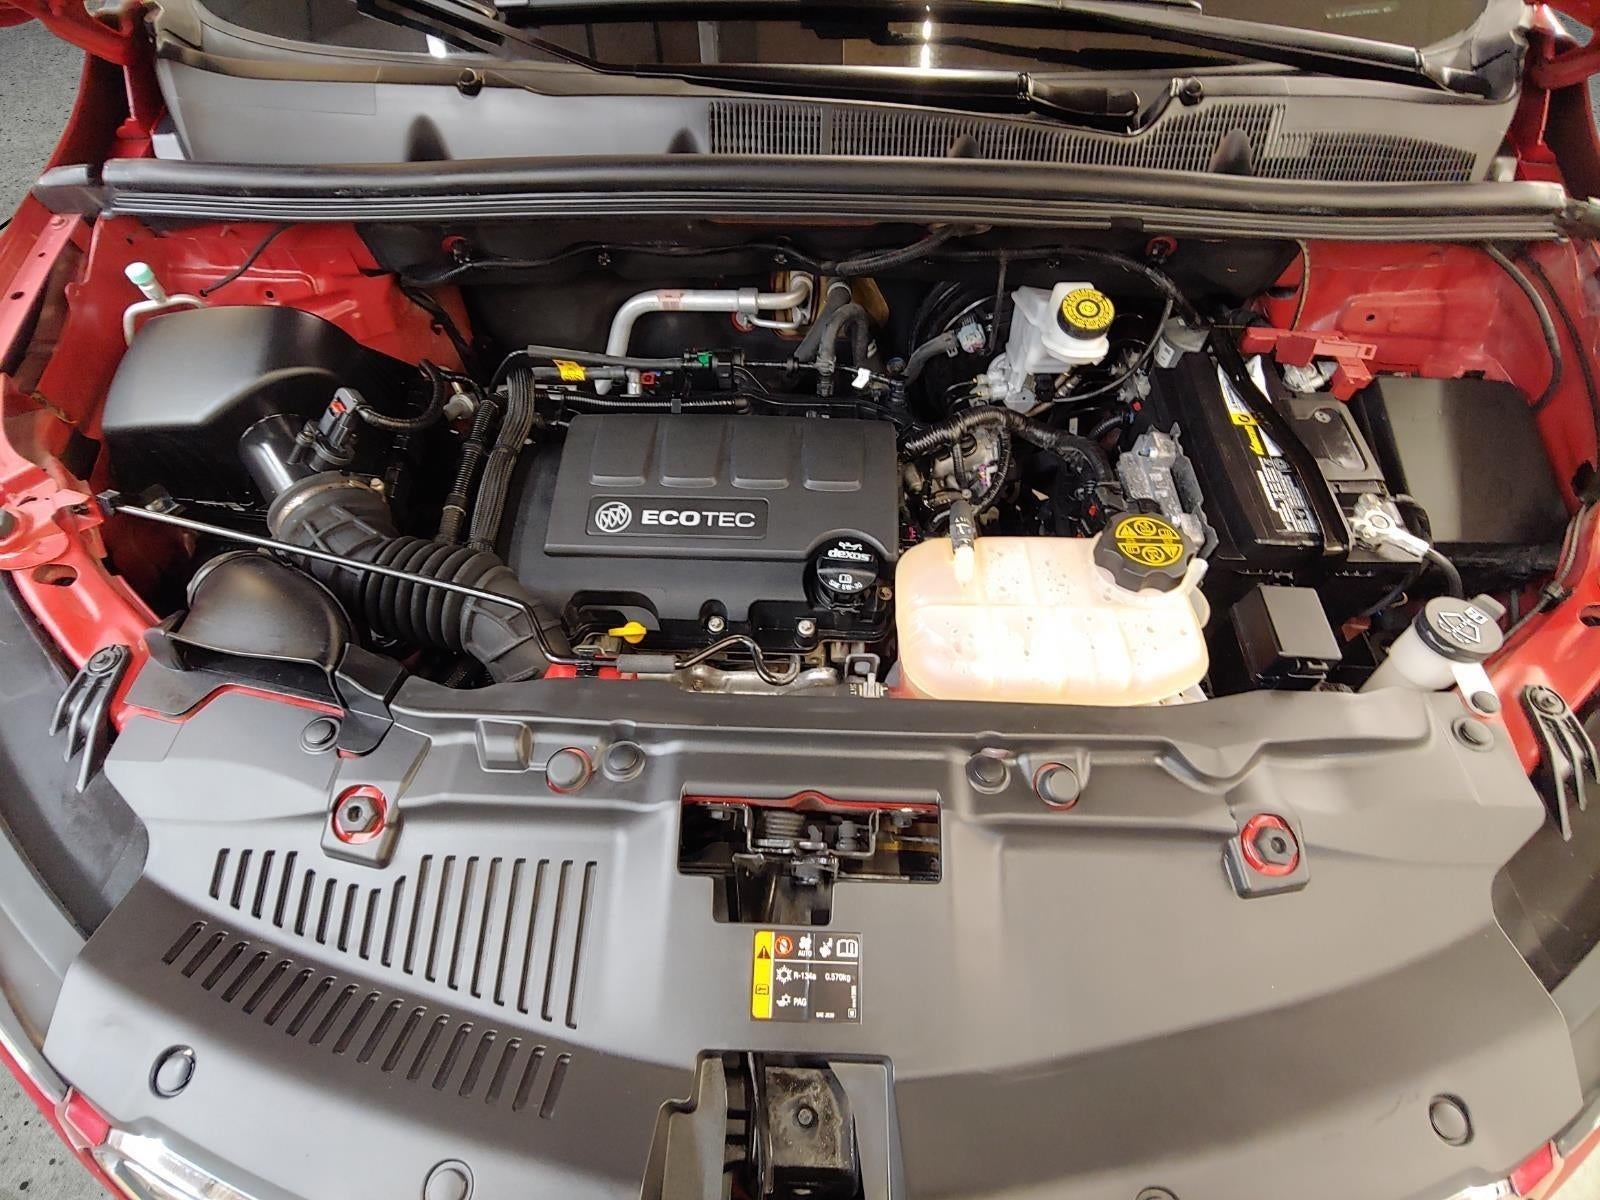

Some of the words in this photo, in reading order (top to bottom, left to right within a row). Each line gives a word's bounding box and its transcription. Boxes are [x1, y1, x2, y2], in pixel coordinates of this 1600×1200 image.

[641, 509, 756, 528] ECOTEC
[828, 548, 871, 562] dexos
[794, 972, 817, 980] R-134a
[825, 973, 851, 982] 0.570kg
[794, 997, 807, 1006] PAG
